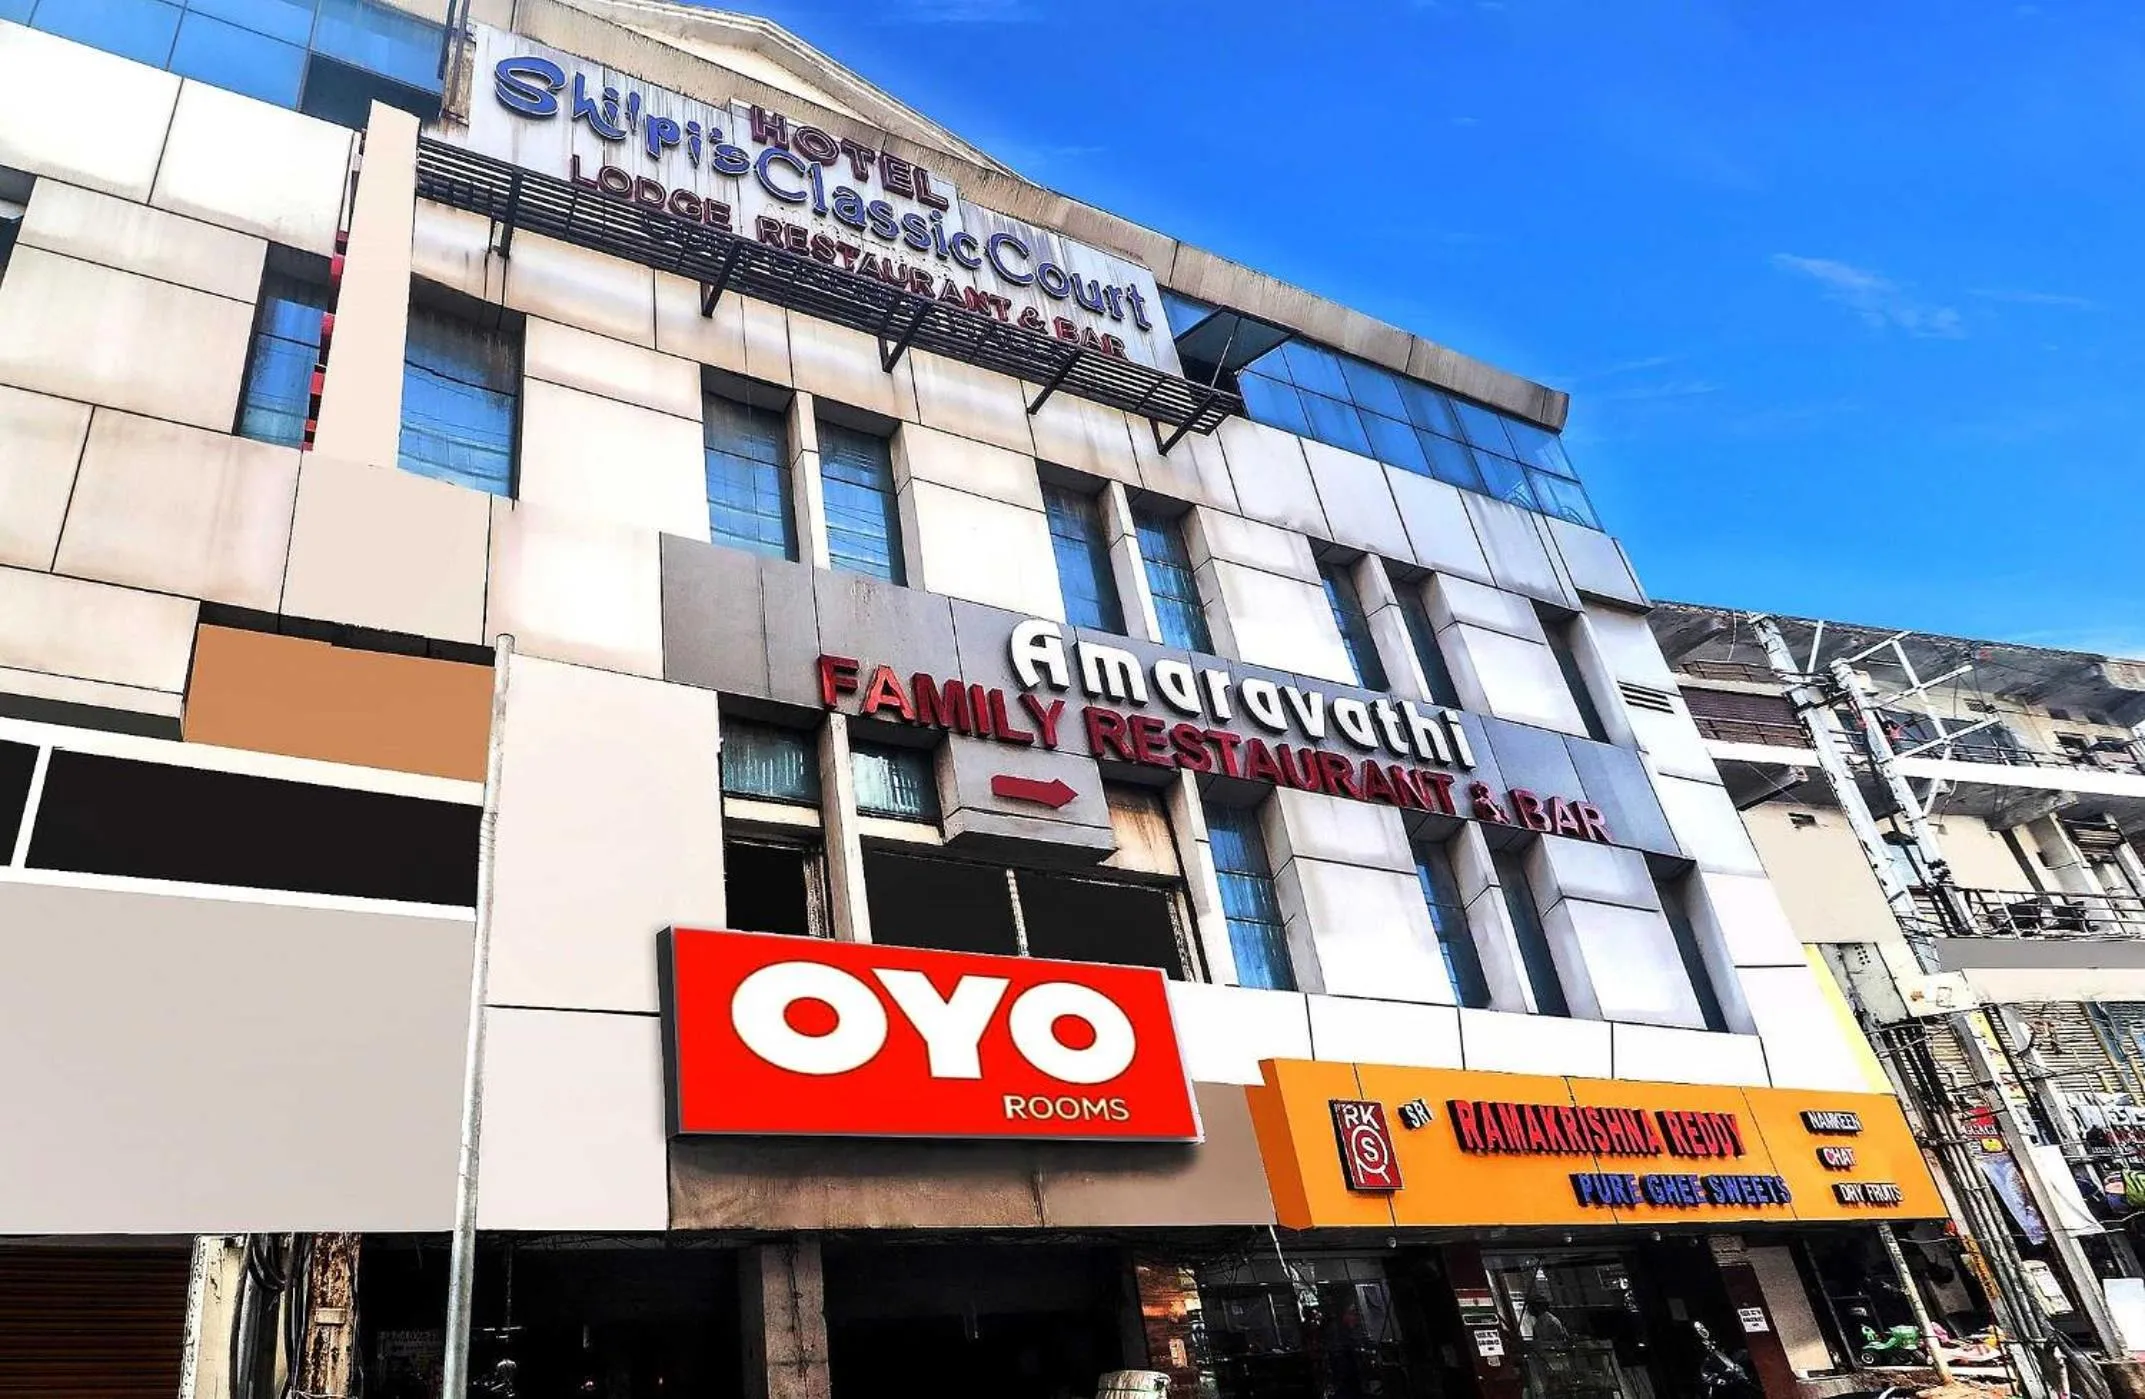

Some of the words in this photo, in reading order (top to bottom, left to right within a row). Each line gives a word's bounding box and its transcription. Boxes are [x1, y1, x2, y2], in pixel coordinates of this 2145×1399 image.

[750, 104, 949, 211] HOTEL
[494, 56, 751, 175] Shilpi's
[754, 146, 983, 270] Classic
[986, 232, 1152, 332] Court
[570, 154, 732, 232] LODGE
[756, 214, 1011, 323] RESTAURANT
[1018, 306, 1047, 334] &
[1054, 316, 1129, 360] BAR
[1009, 617, 1476, 770] Amaravathi
[817, 653, 1065, 749] FAMILY
[1083, 706, 1456, 815] RESTAURANT
[1468, 780, 1510, 824] &
[1509, 787, 1613, 842] BAR
[730, 961, 1136, 1084] OYO
[1004, 1094, 1130, 1121] ROOMS
[1343, 1104, 1381, 1129] RK
[1402, 1099, 1434, 1129] SRI
[1451, 1100, 1663, 1152] RAMAKRISHNA
[1659, 1110, 1746, 1156] REDDY
[1804, 1110, 1863, 1133] NAMKEEN
[1820, 1147, 1856, 1168] CHAT
[1572, 1173, 1642, 1206] PURE
[1641, 1174, 1706, 1207] GHEE
[1704, 1175, 1792, 1205] SWEETS
[1837, 1184, 1866, 1204] DRY
[1863, 1184, 1904, 1204] FRUITS
